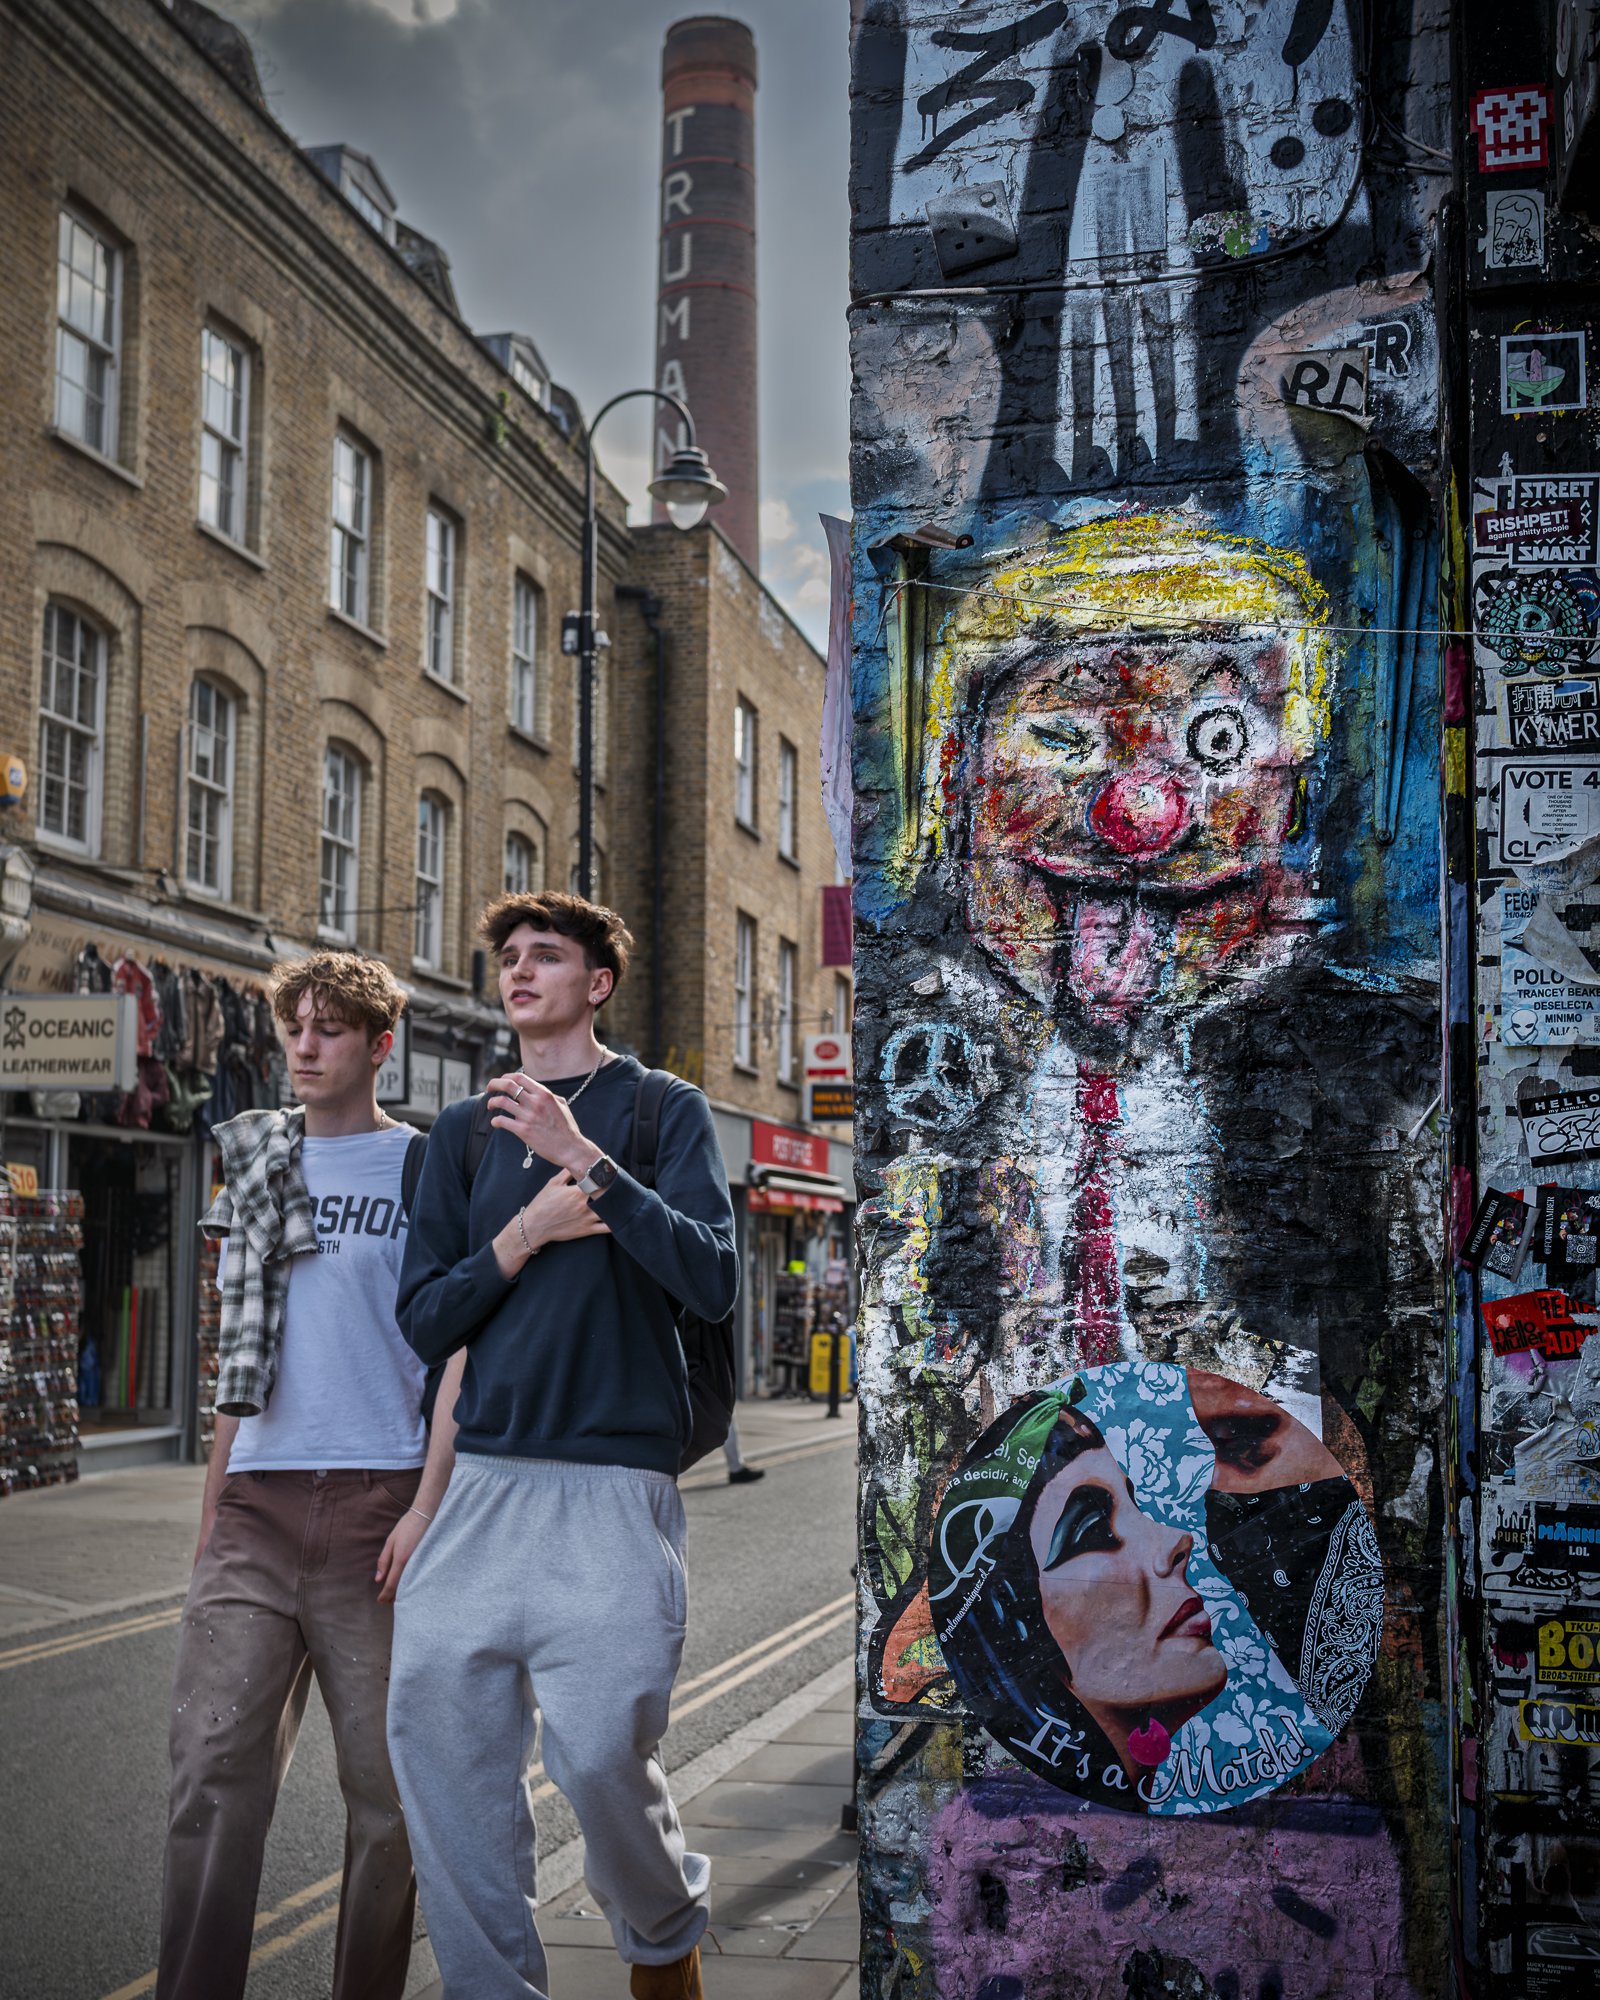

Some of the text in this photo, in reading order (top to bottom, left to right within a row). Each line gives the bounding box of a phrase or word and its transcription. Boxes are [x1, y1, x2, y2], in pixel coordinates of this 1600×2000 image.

[1520, 481, 1594, 498] STREET
[1486, 510, 1569, 533] RISHPET!
[1488, 523, 1569, 541] against shitty people
[1518, 545, 1591, 561] SMART
[1508, 771, 1600, 789] VOTE 4
[1517, 987, 1566, 998] TRANCEY
[1534, 1000, 1594, 1010] DESELECTA
[1545, 1013, 1583, 1023] MINIMO
[29, 1018, 115, 1039] OCEANIC
[2, 1058, 112, 1074] LEATHERWEAR
[1534, 1093, 1600, 1111] HELLO
[1492, 1319, 1536, 1341] hello
[1568, 1545, 1590, 1557] LOL
[1009, 1706, 1314, 1804] It's a Match!
